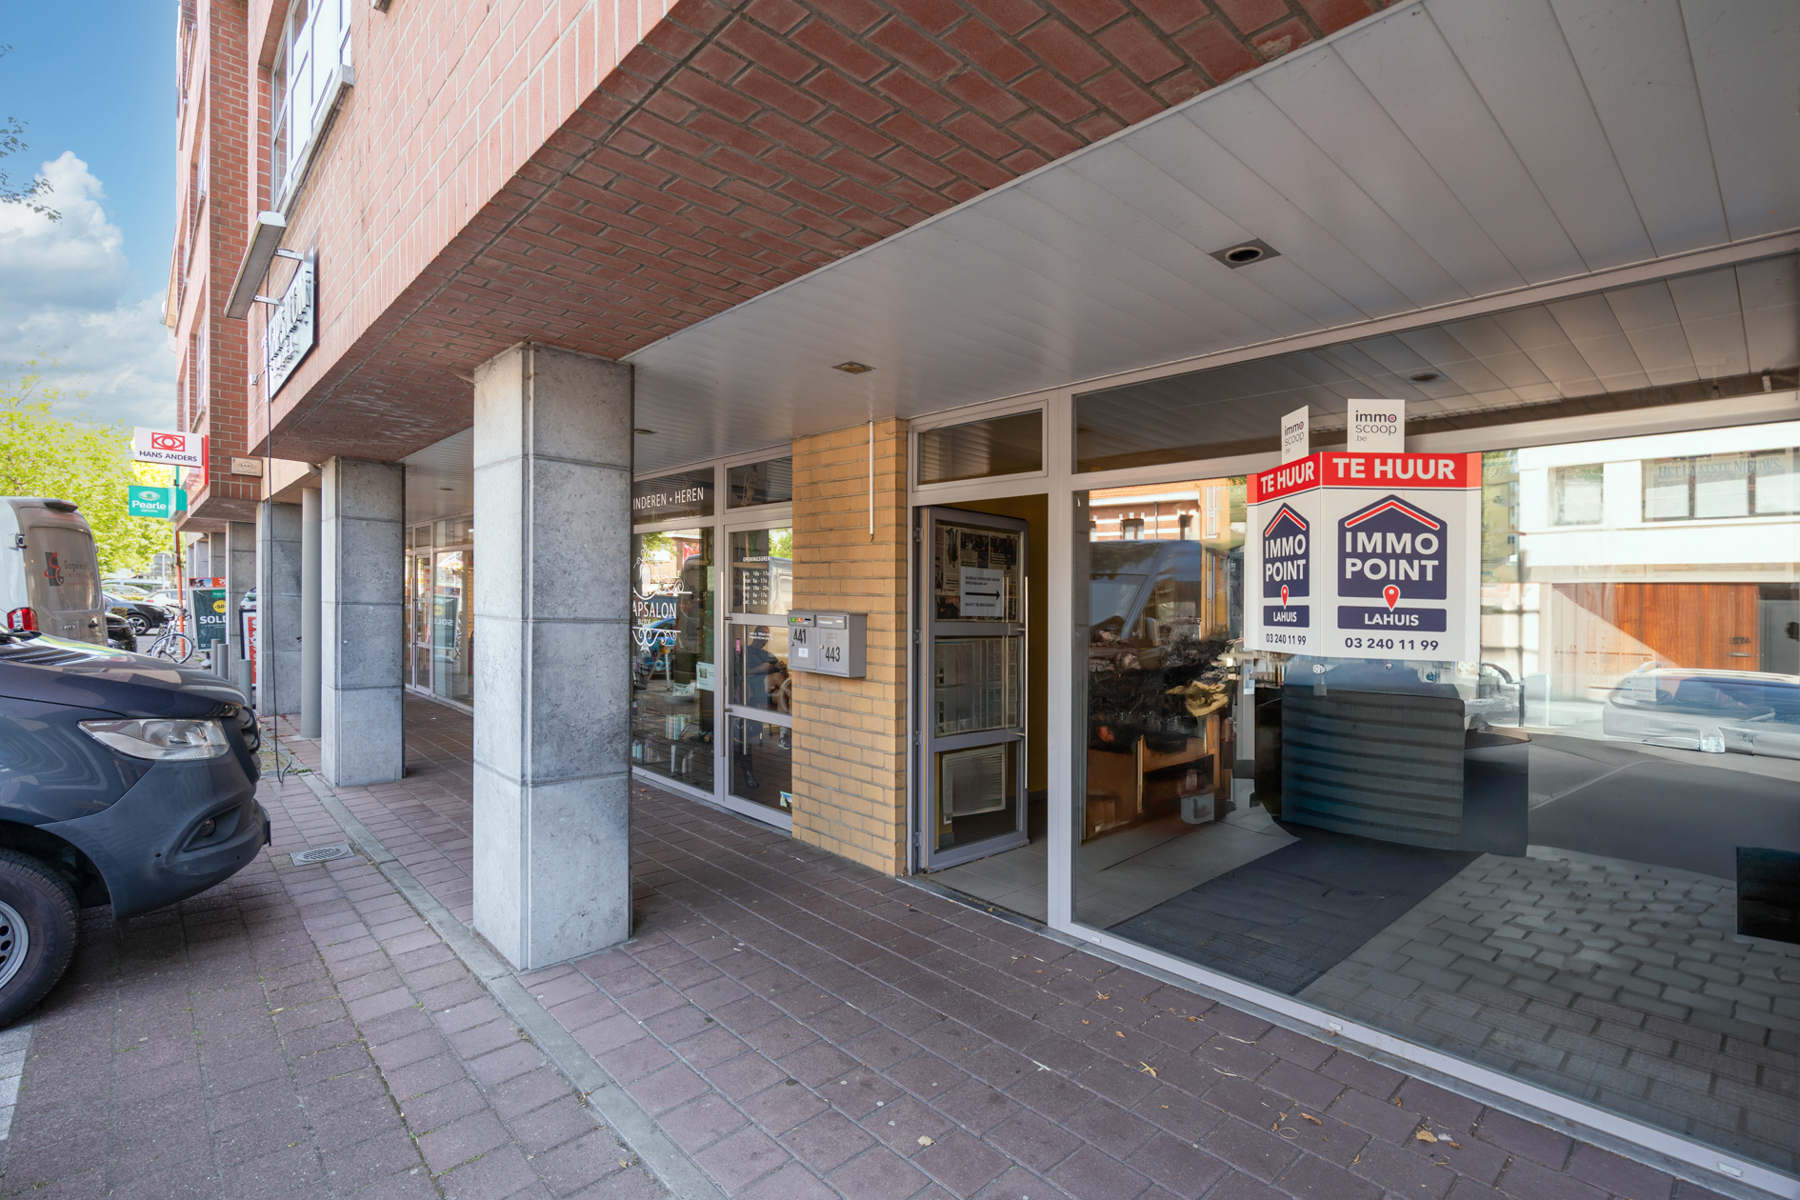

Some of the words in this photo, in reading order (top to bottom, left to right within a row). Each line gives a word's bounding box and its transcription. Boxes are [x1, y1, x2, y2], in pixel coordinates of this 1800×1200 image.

[1355, 410, 1397, 423] immo
[1284, 420, 1304, 437] immo
[1355, 424, 1397, 436] scoop
[1284, 431, 1304, 447] scoop
[139, 450, 162, 458] HANS
[165, 453, 198, 462] ANDERS
[1333, 458, 1365, 478] TE
[1374, 459, 1455, 480] HUUR
[1261, 474, 1274, 495] TE
[1278, 461, 1315, 490] HUUR
[674, 486, 704, 504] HEREN
[132, 500, 166, 510] Pearle
[1265, 533, 1306, 559] IMMO
[1345, 532, 1439, 555] IMMO
[1265, 559, 1306, 582] POINT
[1345, 558, 1439, 581] POINT
[1273, 612, 1297, 623] LAHUIS
[1364, 613, 1419, 626] LAHUIS
[793, 628, 806, 644] 441
[1266, 634, 1273, 643] 03
[1274, 635, 1286, 645] 240
[1288, 635, 1296, 645] 11
[1297, 636, 1306, 646] 99
[1345, 637, 1362, 648] 03
[1367, 638, 1394, 649] 240
[1399, 639, 1415, 650] 11
[1421, 640, 1439, 651] 99
[825, 646, 840, 662] 443
